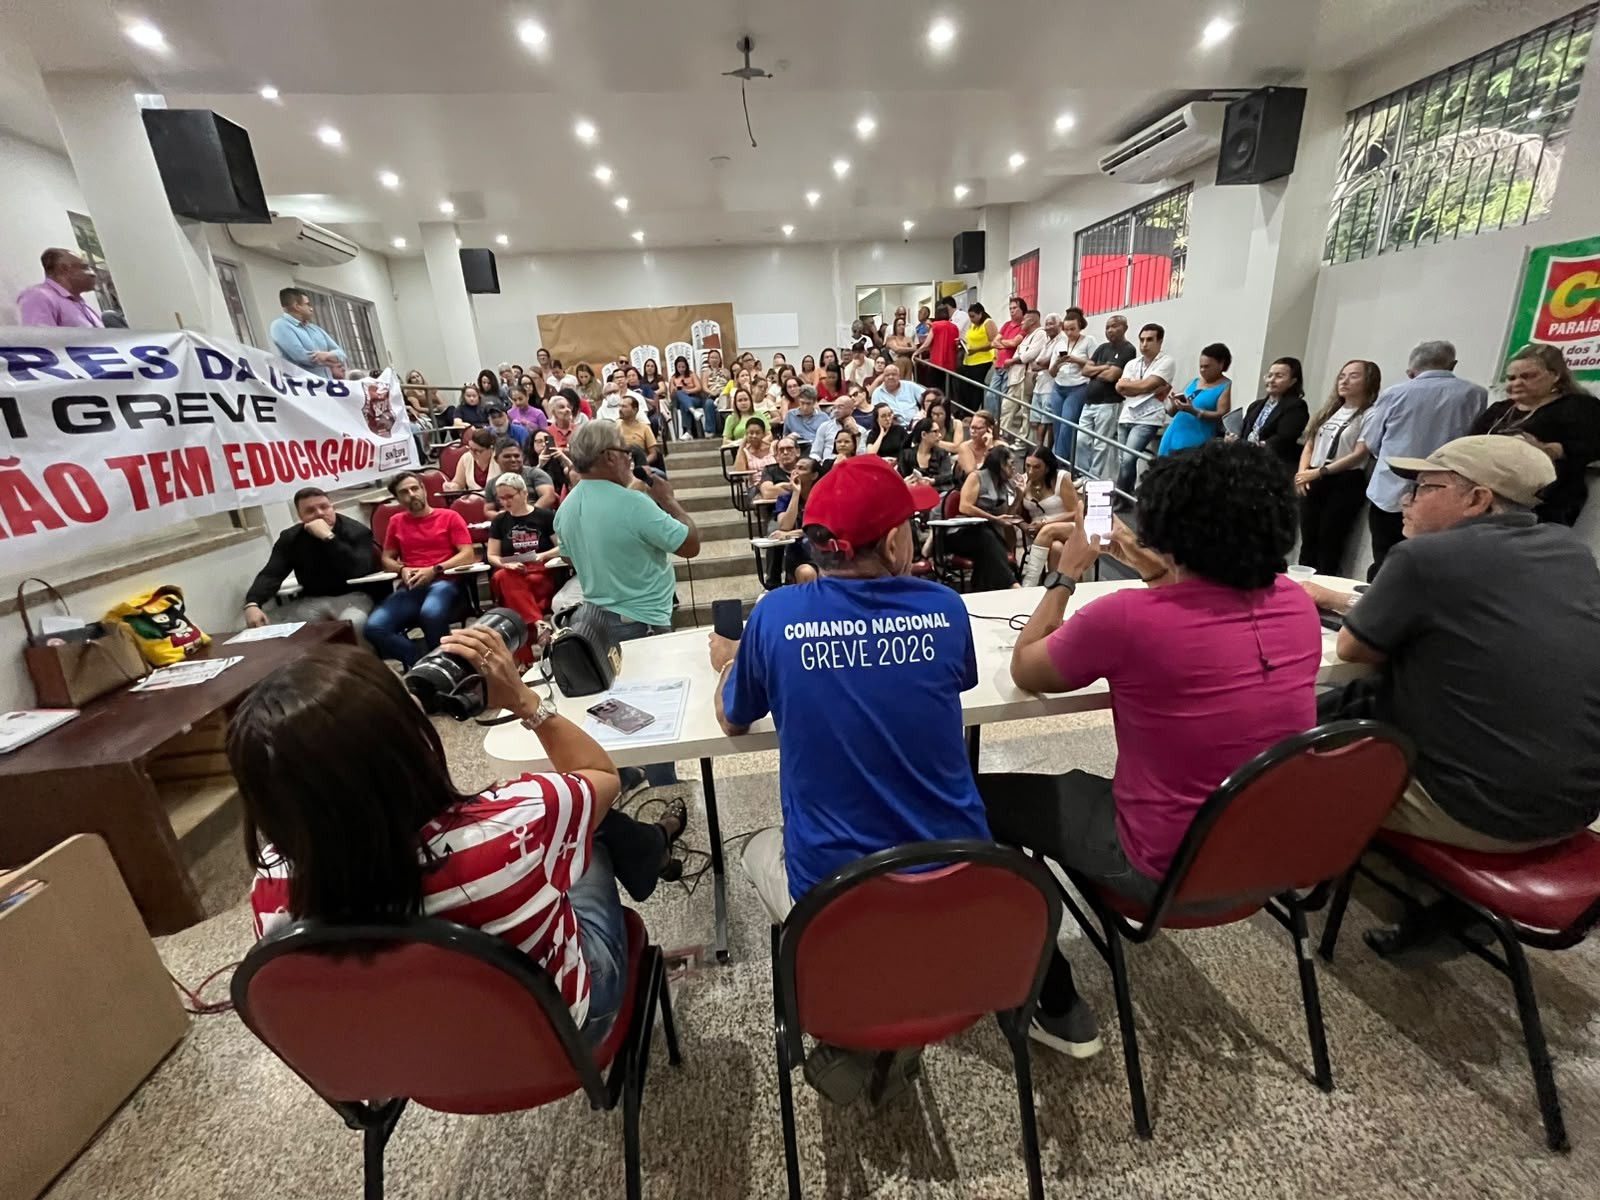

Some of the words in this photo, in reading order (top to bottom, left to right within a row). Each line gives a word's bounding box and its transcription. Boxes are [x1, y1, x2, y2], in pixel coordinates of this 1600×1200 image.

[1548, 316, 1600, 336] PARAÍB
[195, 347, 258, 383] DA
[1566, 345, 1590, 355] dos
[52, 391, 277, 435] GREVE
[0, 455, 109, 541] ÃO
[104, 446, 216, 512] TEM
[222, 433, 376, 490] EDUCAÇÃO!
[784, 619, 867, 640] COMANDO
[872, 612, 950, 635] NACIONAL
[801, 640, 873, 670] GREVE
[877, 633, 936, 667] 2026
